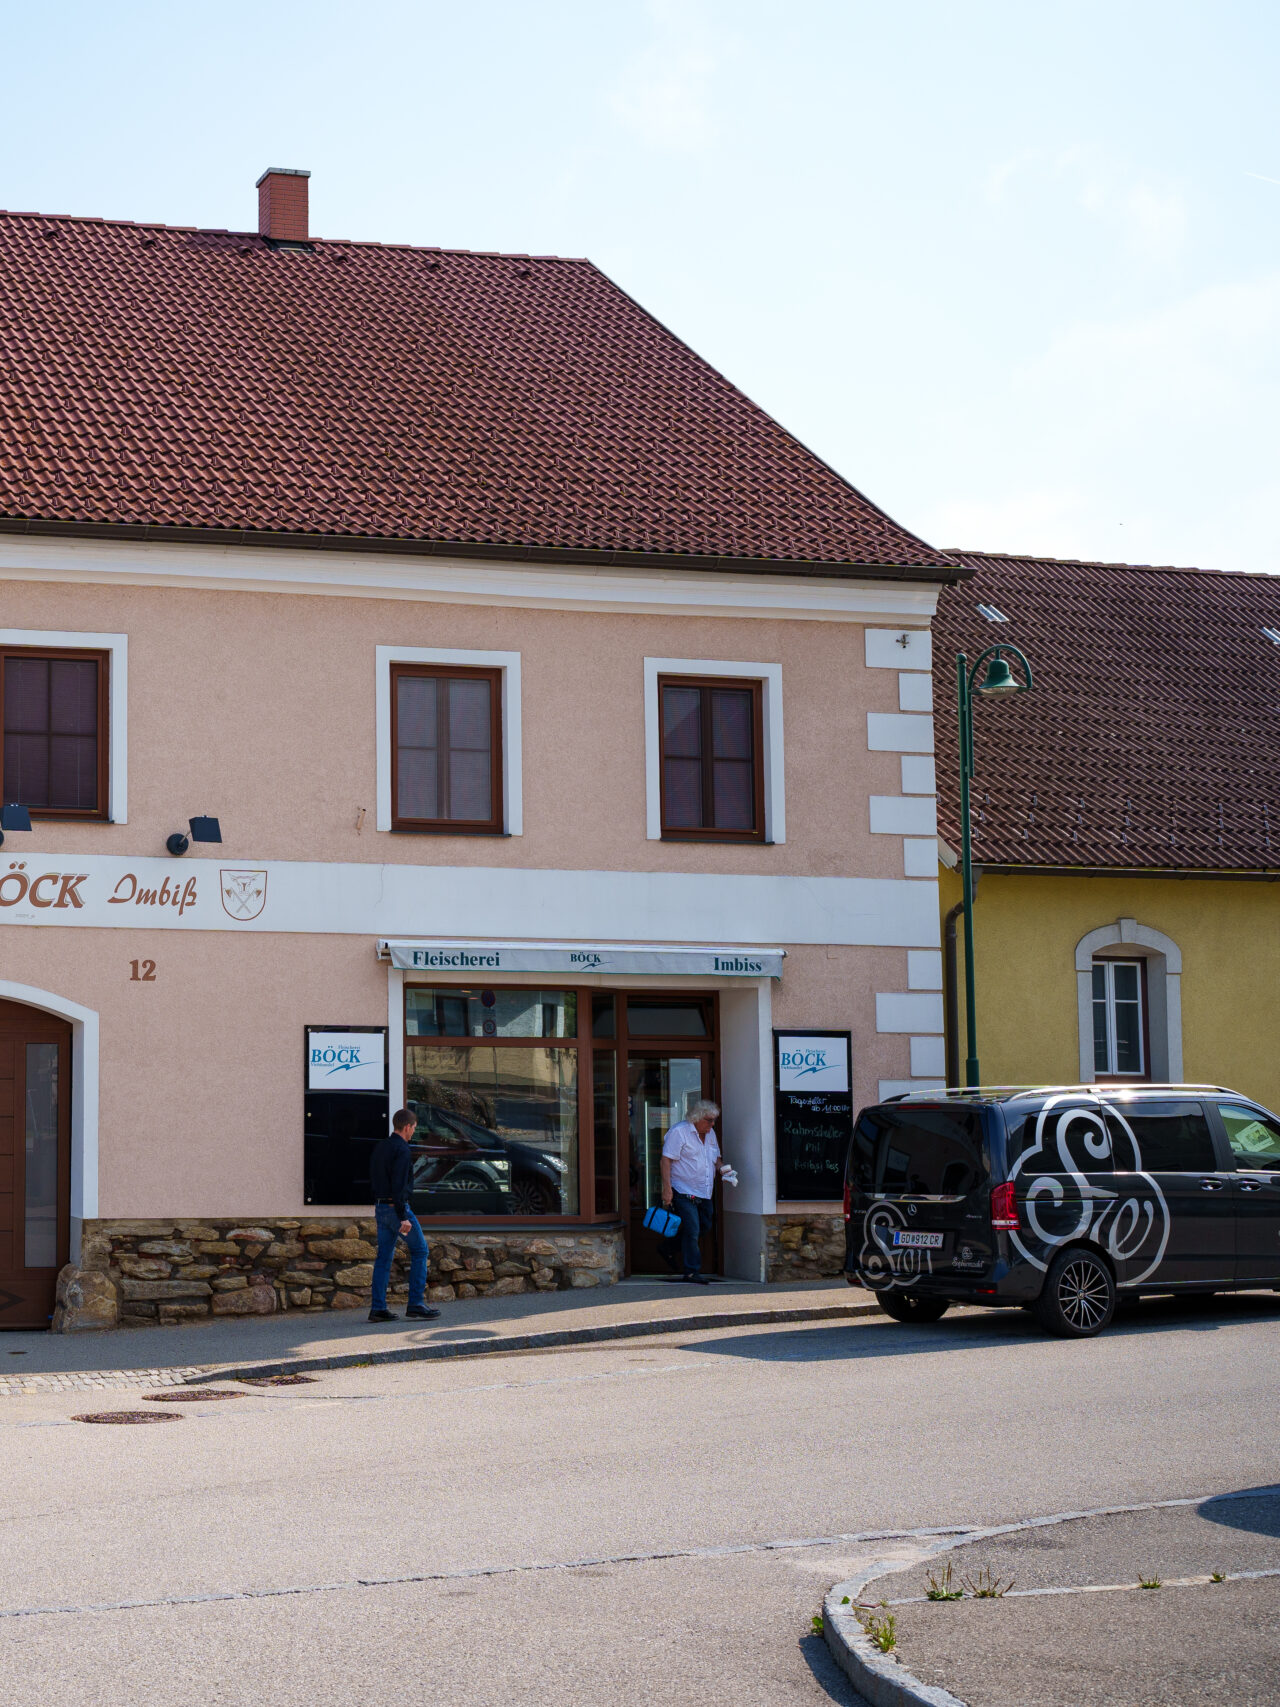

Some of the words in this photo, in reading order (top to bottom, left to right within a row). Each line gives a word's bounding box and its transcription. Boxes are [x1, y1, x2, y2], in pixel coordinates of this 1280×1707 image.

[107, 873, 197, 916] Imbiß
[129, 959, 157, 982] 12
[413, 951, 500, 967] Fleischerei
[570, 952, 601, 963] BÖCK
[713, 957, 763, 972] Imbiss
[311, 1046, 361, 1063] BÖCK
[781, 1049, 826, 1066] BÖCK
[916, 1235, 928, 1245] 912
